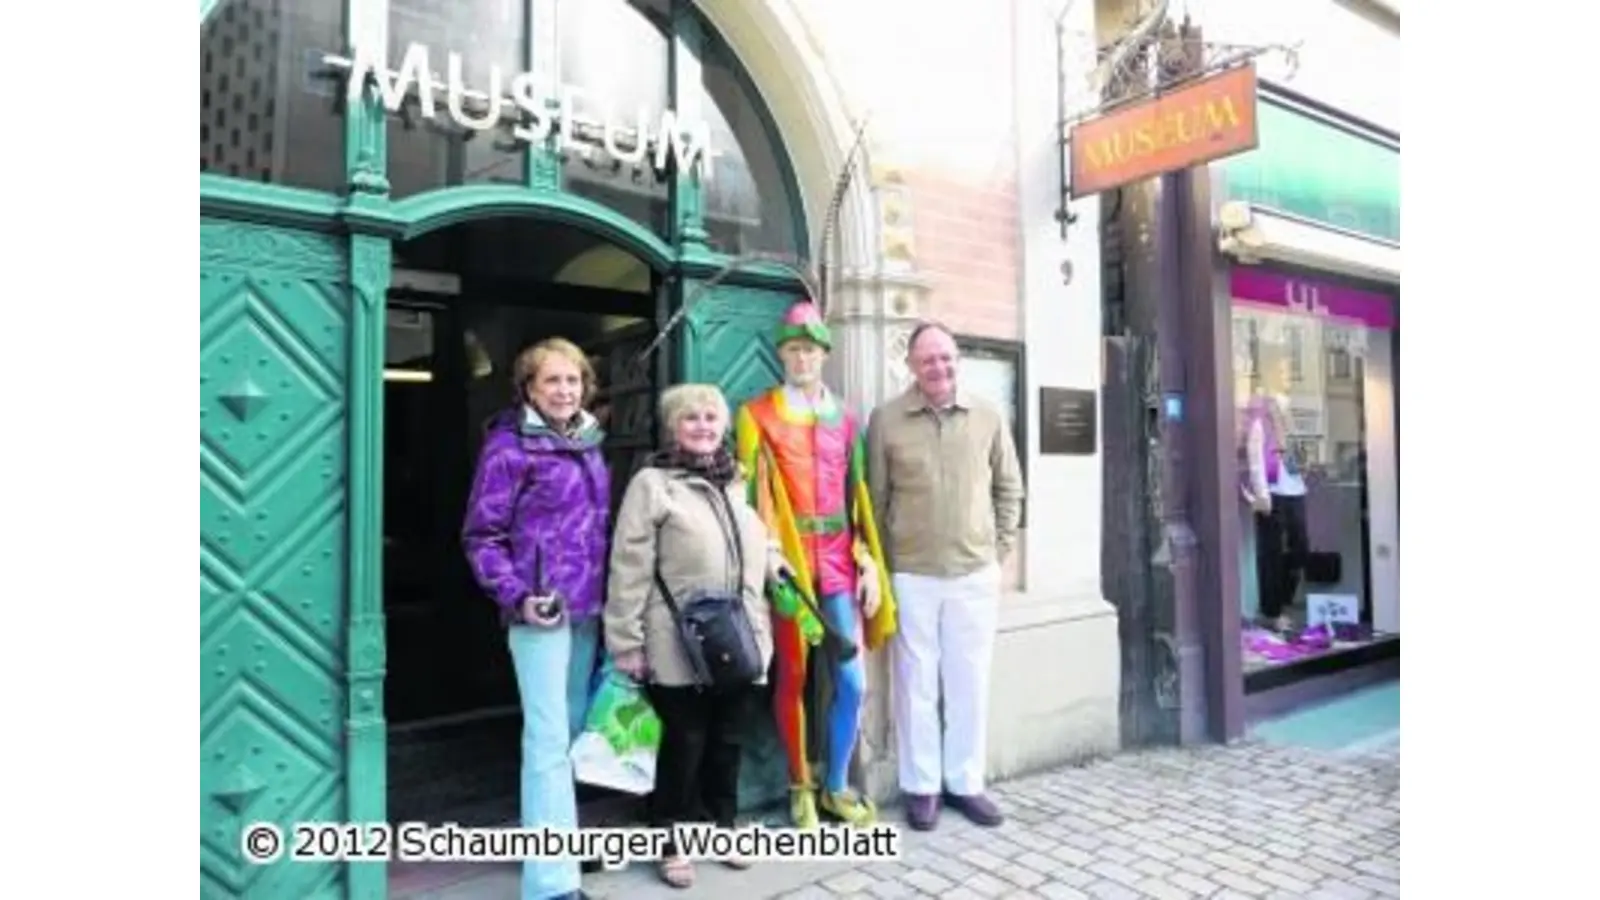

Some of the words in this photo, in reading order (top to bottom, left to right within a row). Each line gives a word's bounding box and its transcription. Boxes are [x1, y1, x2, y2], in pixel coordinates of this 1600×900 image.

[346, 41, 713, 181] MUSEUM
[1084, 95, 1240, 171] MUSEUM
[1060, 259, 1074, 286] 9
